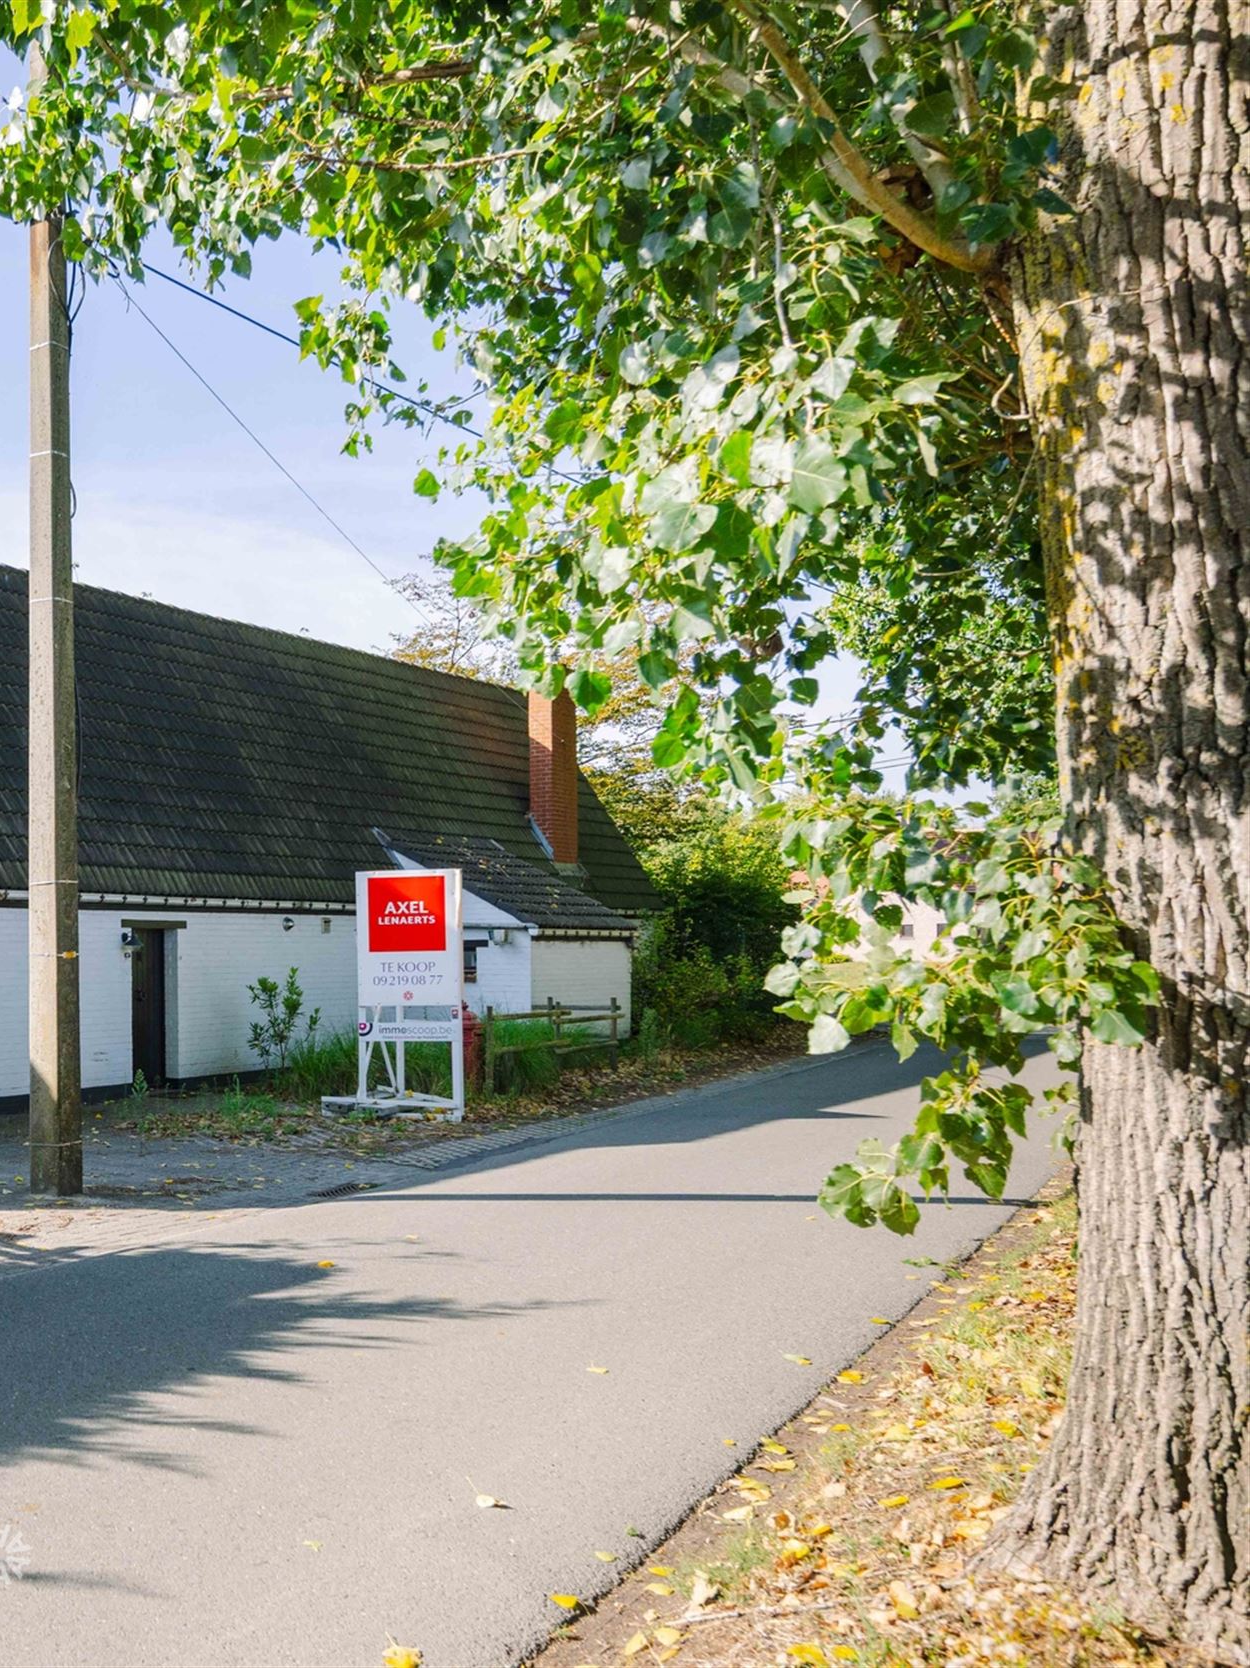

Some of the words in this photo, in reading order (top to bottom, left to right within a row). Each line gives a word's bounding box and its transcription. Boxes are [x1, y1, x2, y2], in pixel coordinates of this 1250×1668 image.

[384, 901, 429, 914] AXEL
[378, 915, 436, 925] LENAERTS
[380, 962, 395, 973] TE
[397, 961, 436, 973] KOOP
[373, 975, 388, 986] 09
[389, 975, 409, 986] 219
[411, 975, 427, 985] 08
[429, 974, 443, 985] 77
[378, 1026, 453, 1036] immoscoop.be
